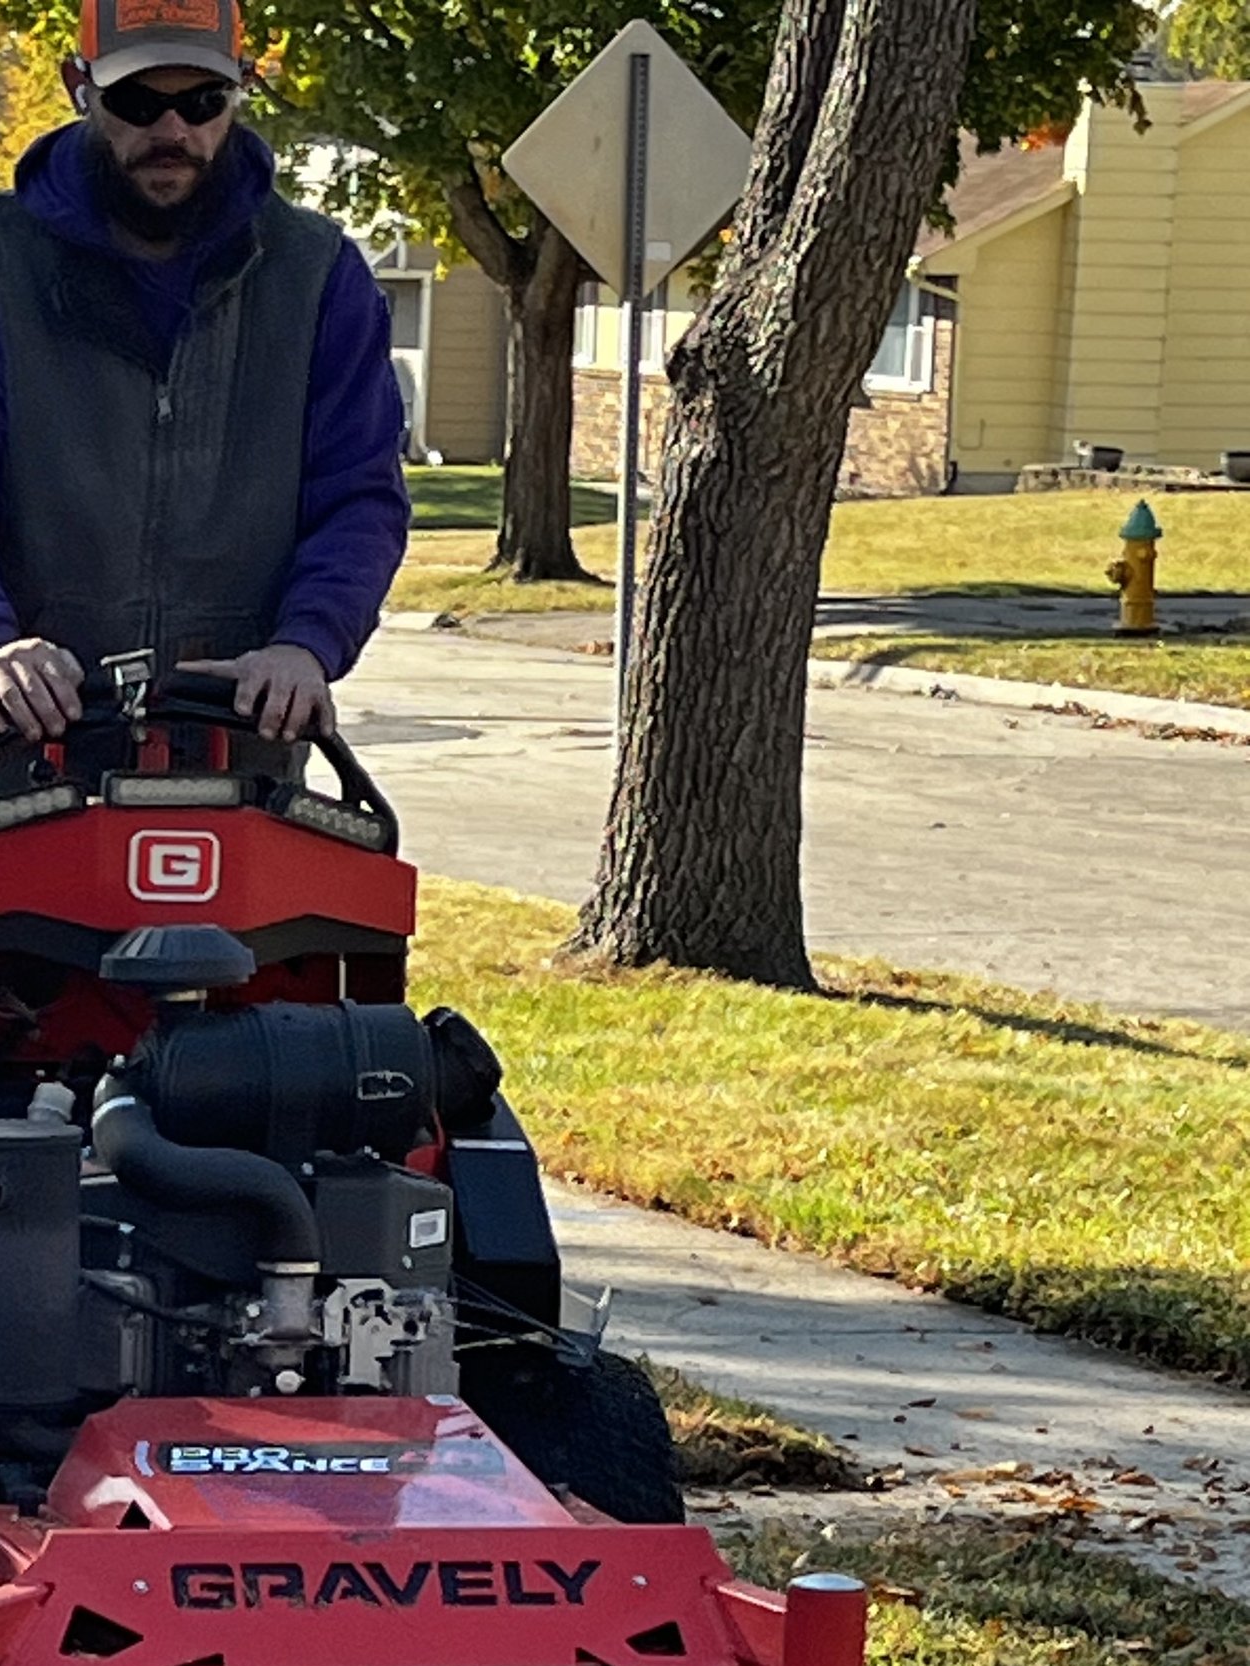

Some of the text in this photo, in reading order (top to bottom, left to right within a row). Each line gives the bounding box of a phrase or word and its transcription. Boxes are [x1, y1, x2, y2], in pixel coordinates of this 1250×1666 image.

[149, 844, 200, 886] G
[170, 1457, 390, 1472] STANCE
[170, 1561, 600, 1608] GRAVELY
